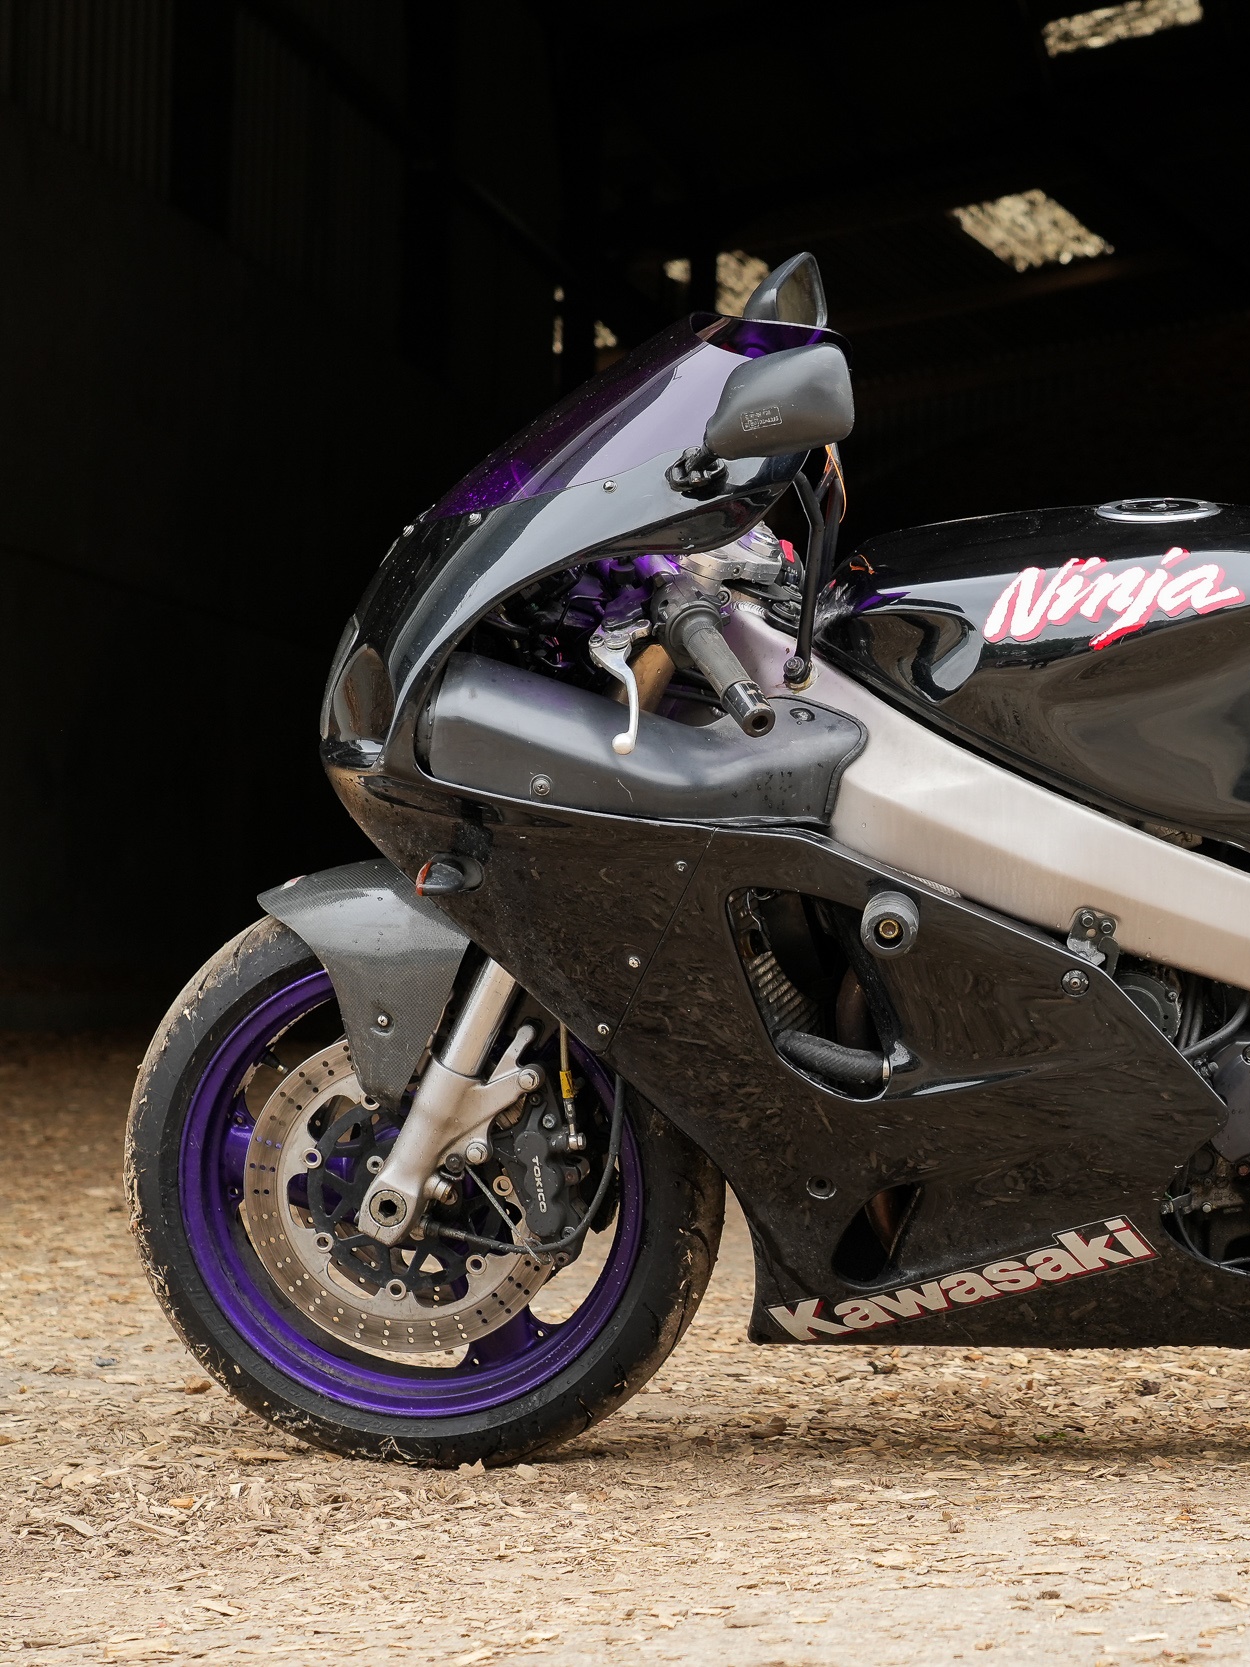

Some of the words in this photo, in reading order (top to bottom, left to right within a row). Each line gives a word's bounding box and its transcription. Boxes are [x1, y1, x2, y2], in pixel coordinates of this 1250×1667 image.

[983, 547, 1246, 651] Ninja
[532, 1155, 547, 1213] TOKICO
[768, 1218, 1157, 1341] Kawasaki
